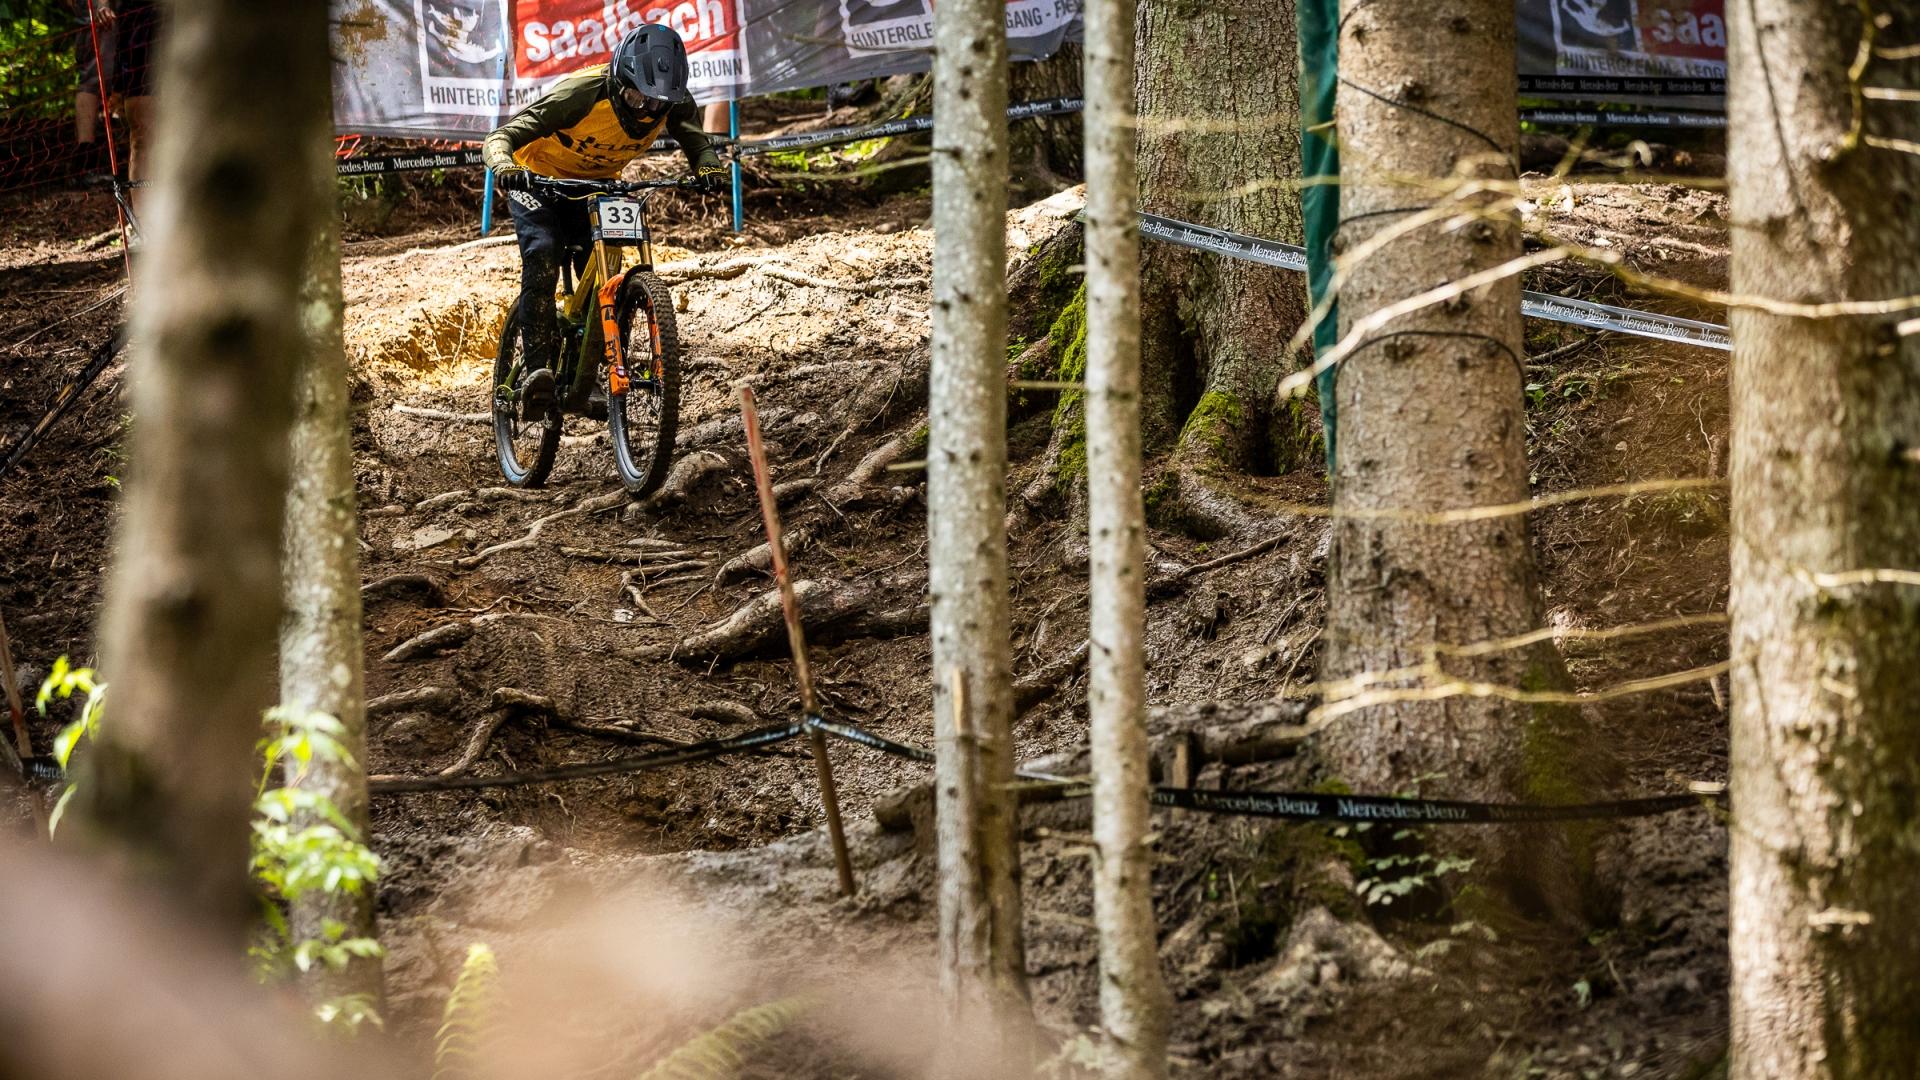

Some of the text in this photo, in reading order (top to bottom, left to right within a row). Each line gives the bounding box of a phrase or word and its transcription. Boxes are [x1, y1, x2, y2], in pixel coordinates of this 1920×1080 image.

[1006, 102, 1052, 116] cedes-Benz
[336, 160, 385, 173] cedes-Benz
[393, 154, 457, 170] Mercedes-Benz
[607, 207, 635, 224] 33
[1180, 228, 1243, 254] Mercedes-Benz
[1540, 300, 1610, 324] Mercedes-Benz
[1618, 313, 1691, 338] Mercedes-Benz
[1336, 798, 1470, 820] Mercedes-Benz
